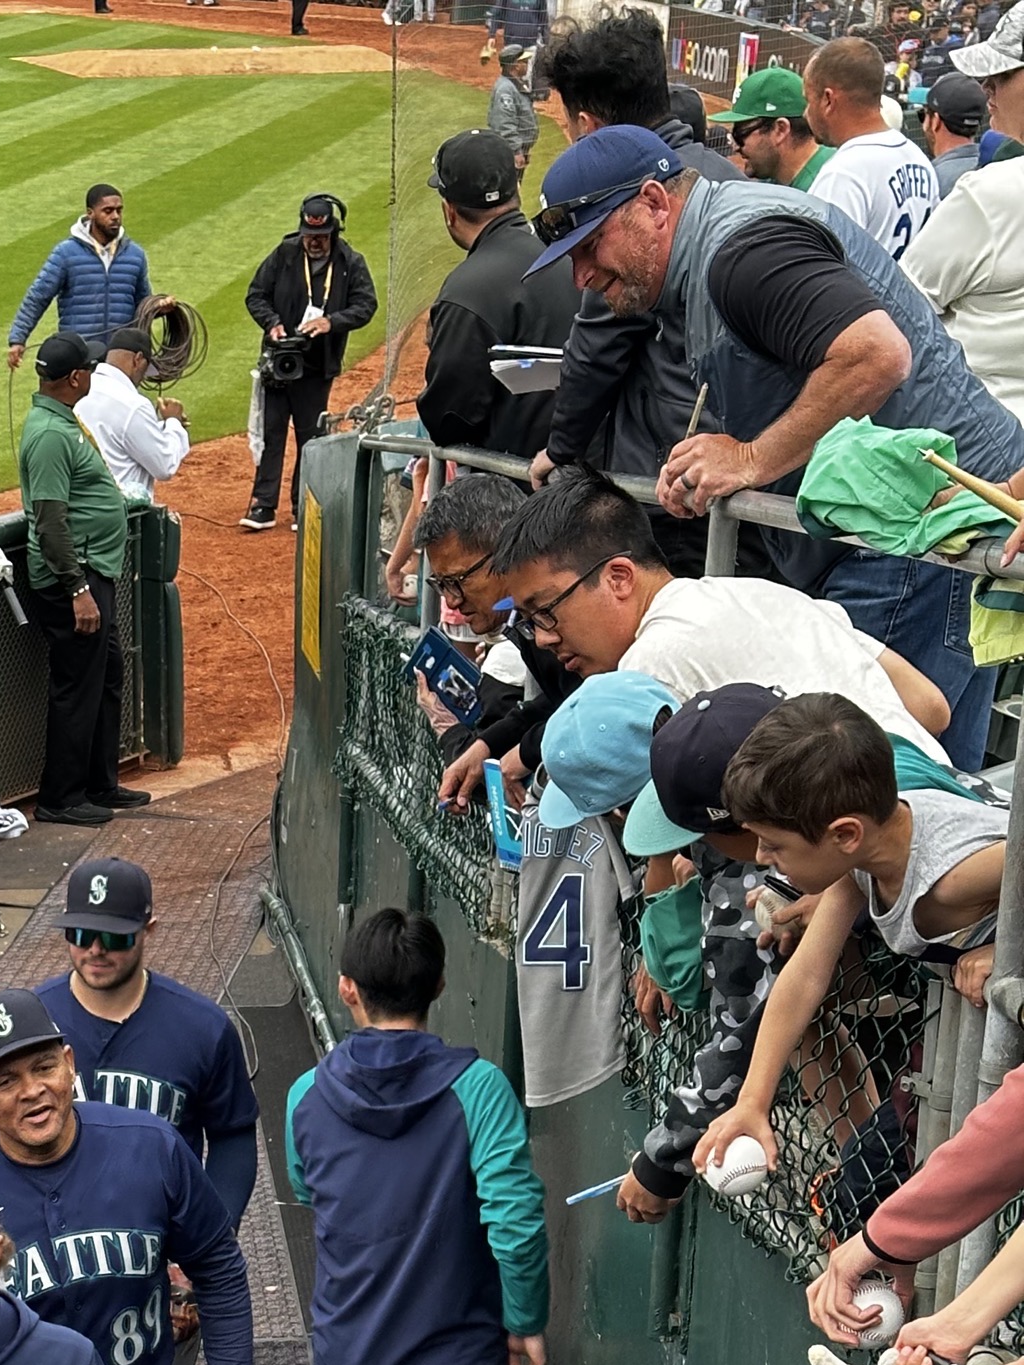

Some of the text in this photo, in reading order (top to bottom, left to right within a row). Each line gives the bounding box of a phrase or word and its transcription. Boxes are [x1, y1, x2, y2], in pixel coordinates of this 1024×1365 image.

[522, 819, 606, 869] IGUEZ
[88, 874, 109, 905] S
[522, 872, 591, 991] 4
